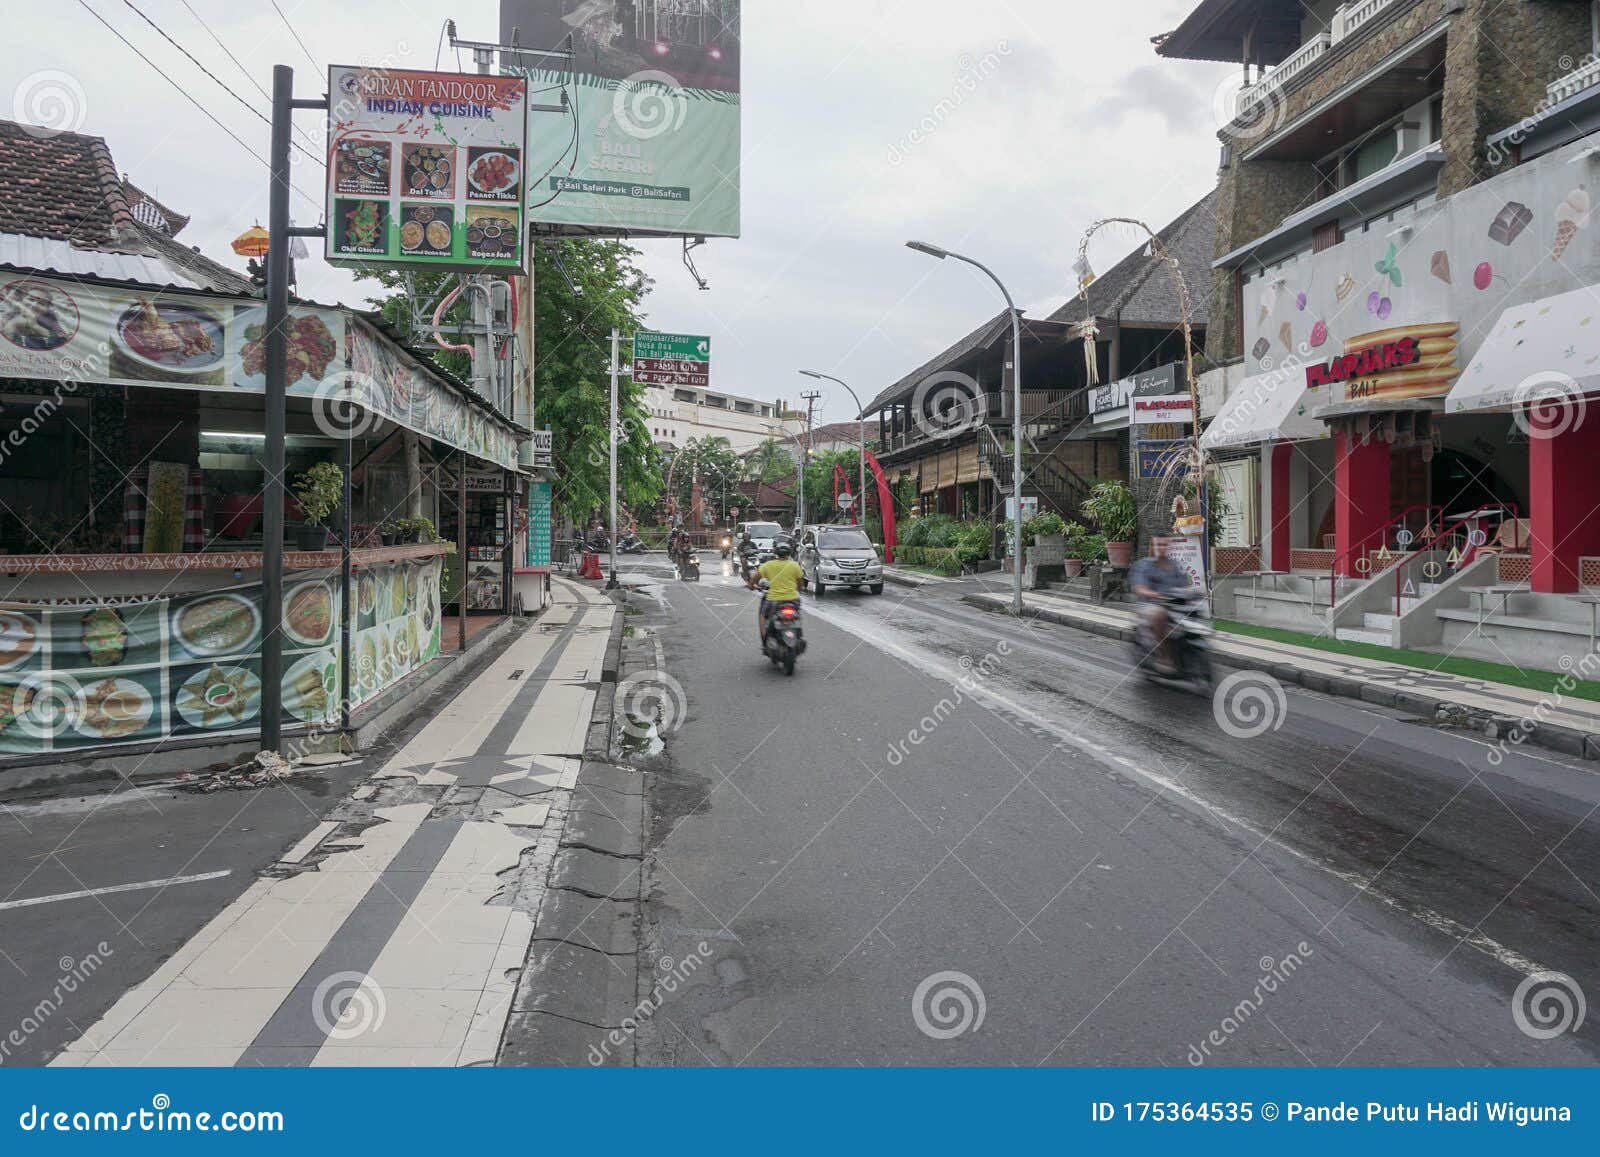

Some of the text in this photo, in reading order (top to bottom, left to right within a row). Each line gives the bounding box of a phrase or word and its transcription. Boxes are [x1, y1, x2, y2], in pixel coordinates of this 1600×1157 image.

[363, 77, 414, 97] KIRAN
[418, 80, 498, 101] TANDOOR
[367, 98, 493, 117] INDIAN CUISINE
[601, 141, 641, 157] BALI
[589, 155, 654, 175] SAFARI
[564, 181, 682, 199] Bali Safari Park BaliSafari
[1305, 336, 1420, 389] FLAPJAKS
[653, 374, 673, 382] Pasar
[691, 376, 706, 384] Kuta
[1350, 379, 1379, 399] BALI
